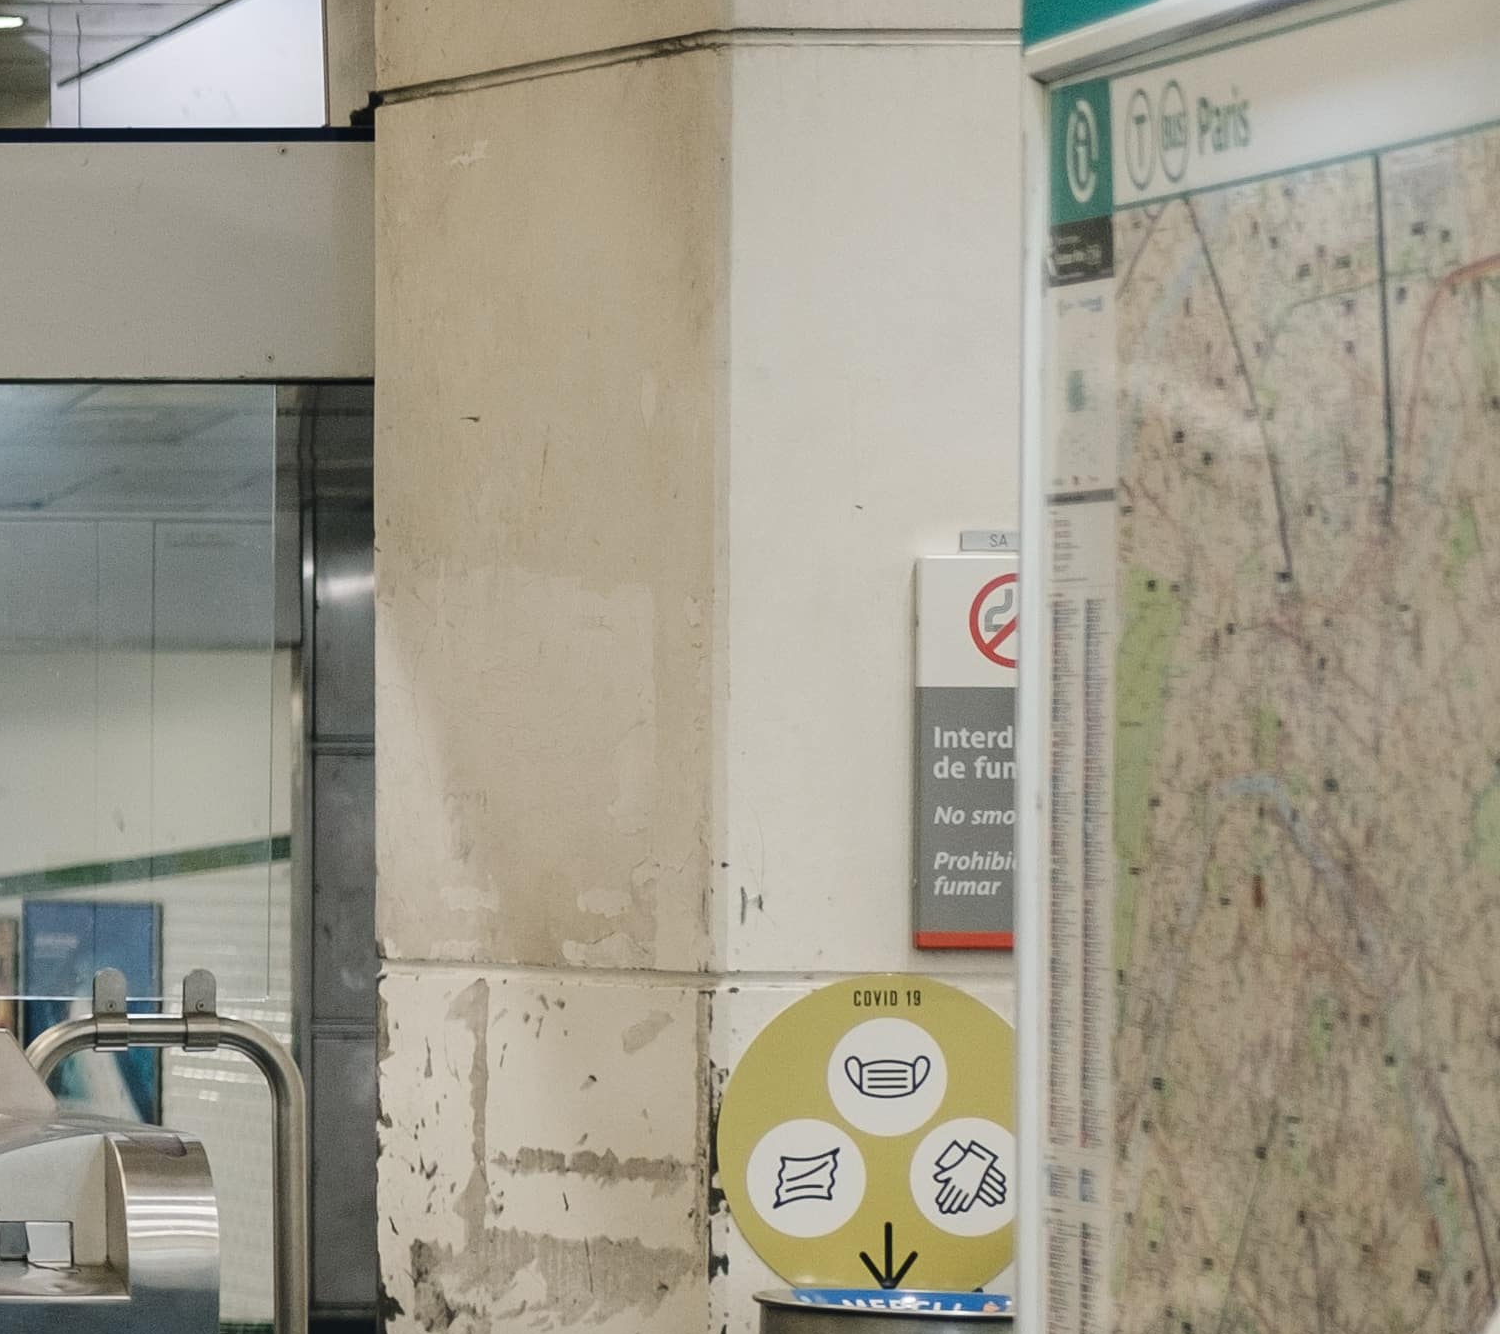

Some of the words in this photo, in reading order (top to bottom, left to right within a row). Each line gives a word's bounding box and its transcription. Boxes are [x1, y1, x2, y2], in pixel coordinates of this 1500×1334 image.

[1198, 85, 1249, 154] Paris
[933, 756, 965, 779] de
[933, 806, 965, 825] No
[933, 876, 1002, 895] fumar
[853, 990, 899, 1007] COVID
[906, 989, 922, 1007] 19
